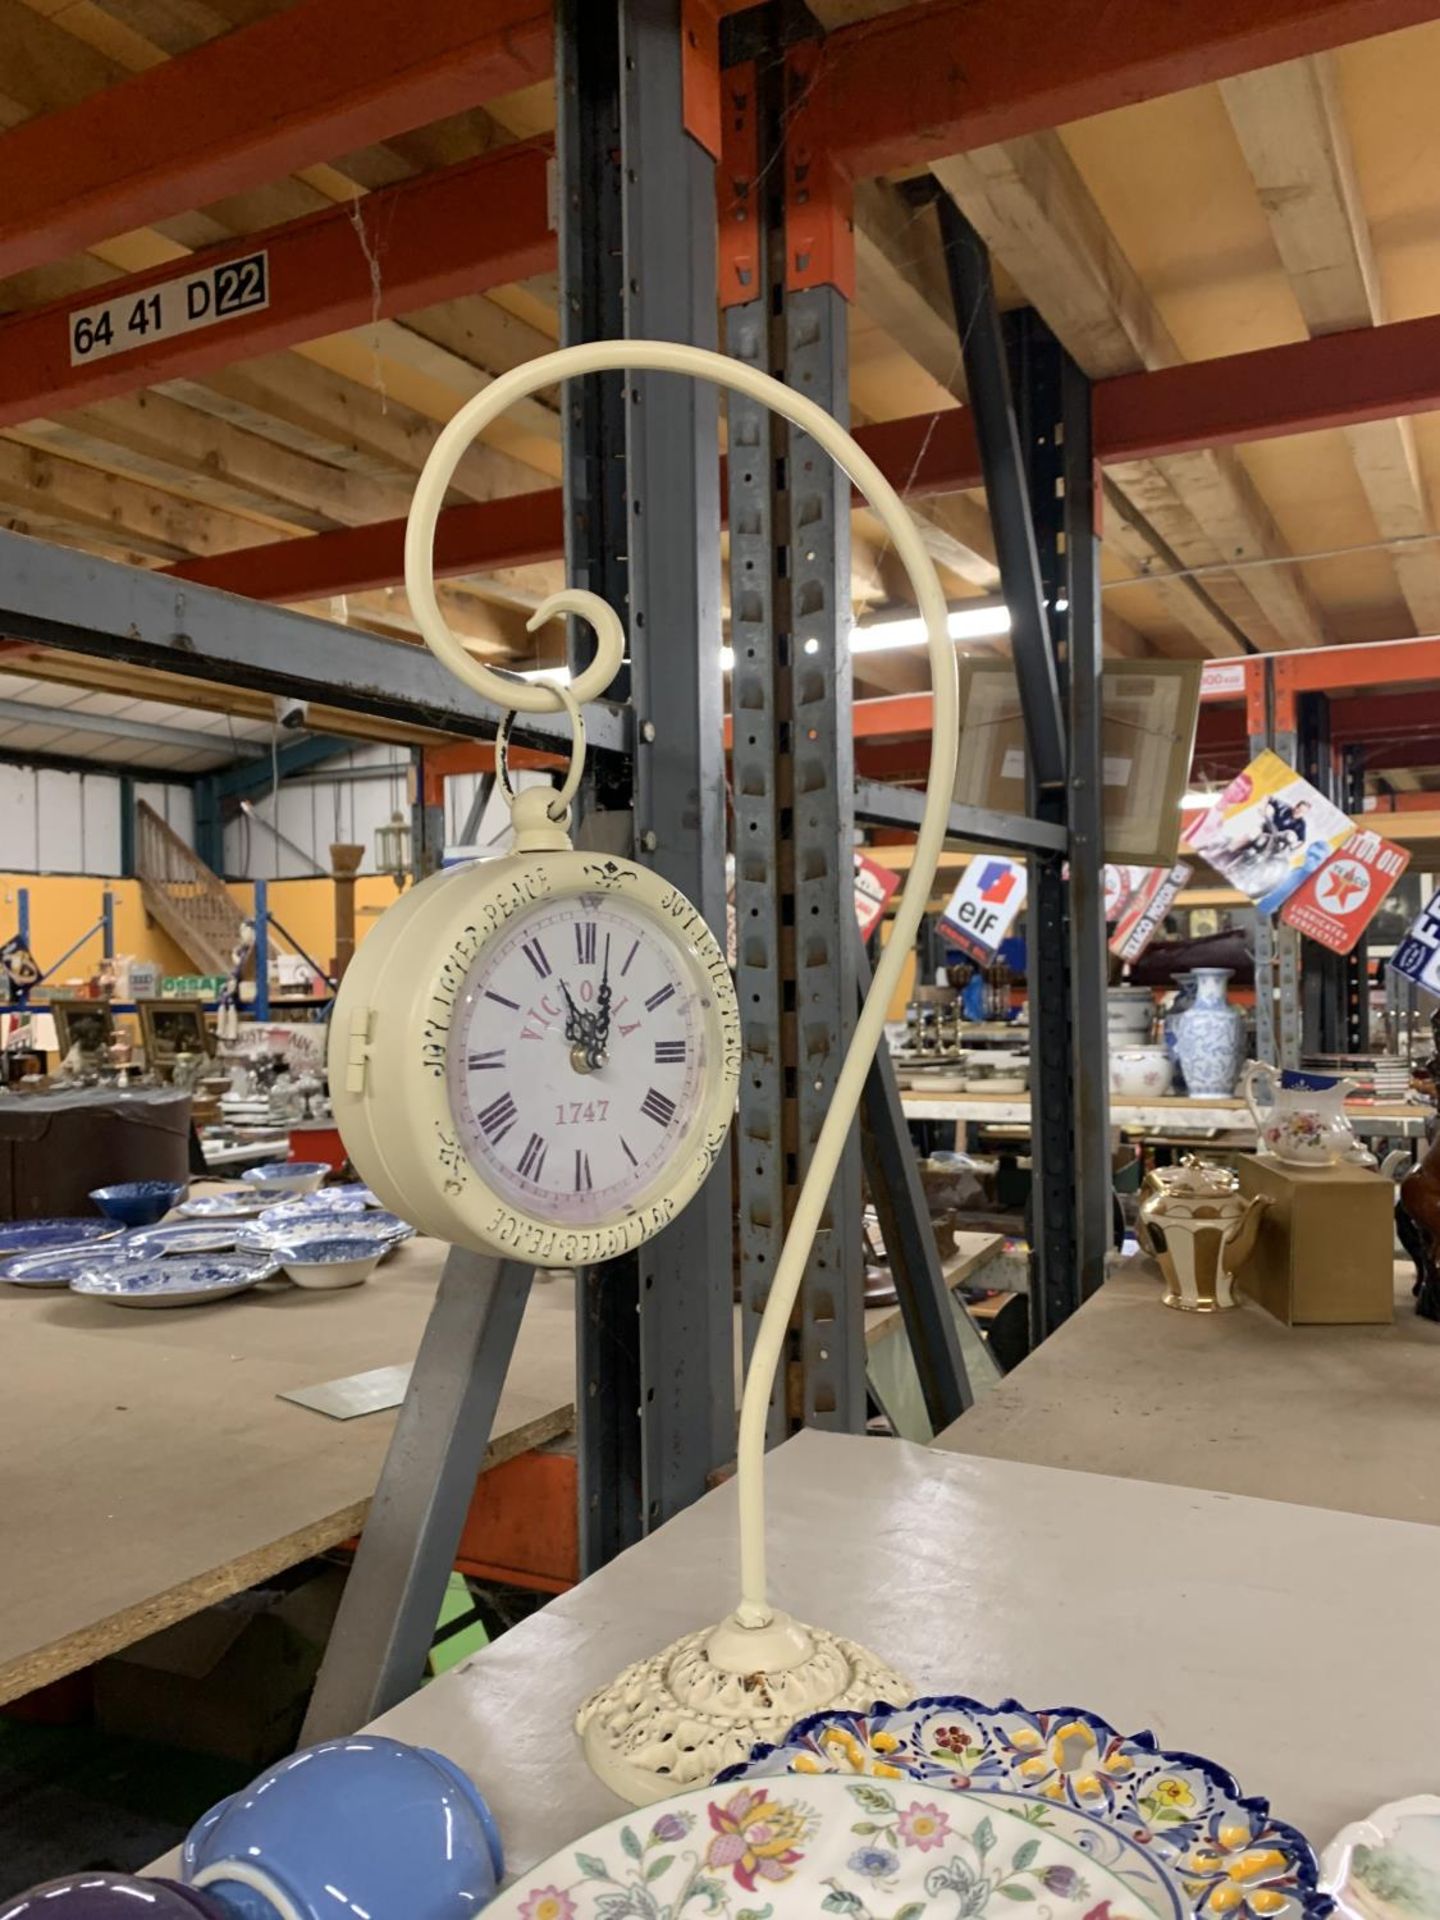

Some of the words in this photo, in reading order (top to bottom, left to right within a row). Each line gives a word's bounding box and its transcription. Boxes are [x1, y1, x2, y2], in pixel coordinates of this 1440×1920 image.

[74, 311, 113, 354] 64
[128, 294, 161, 335] 41
[1376, 849, 1404, 877] OIL
[958, 901, 999, 935] elf
[520, 980, 641, 1041] VICOIA
[554, 1100, 610, 1125] 1747
